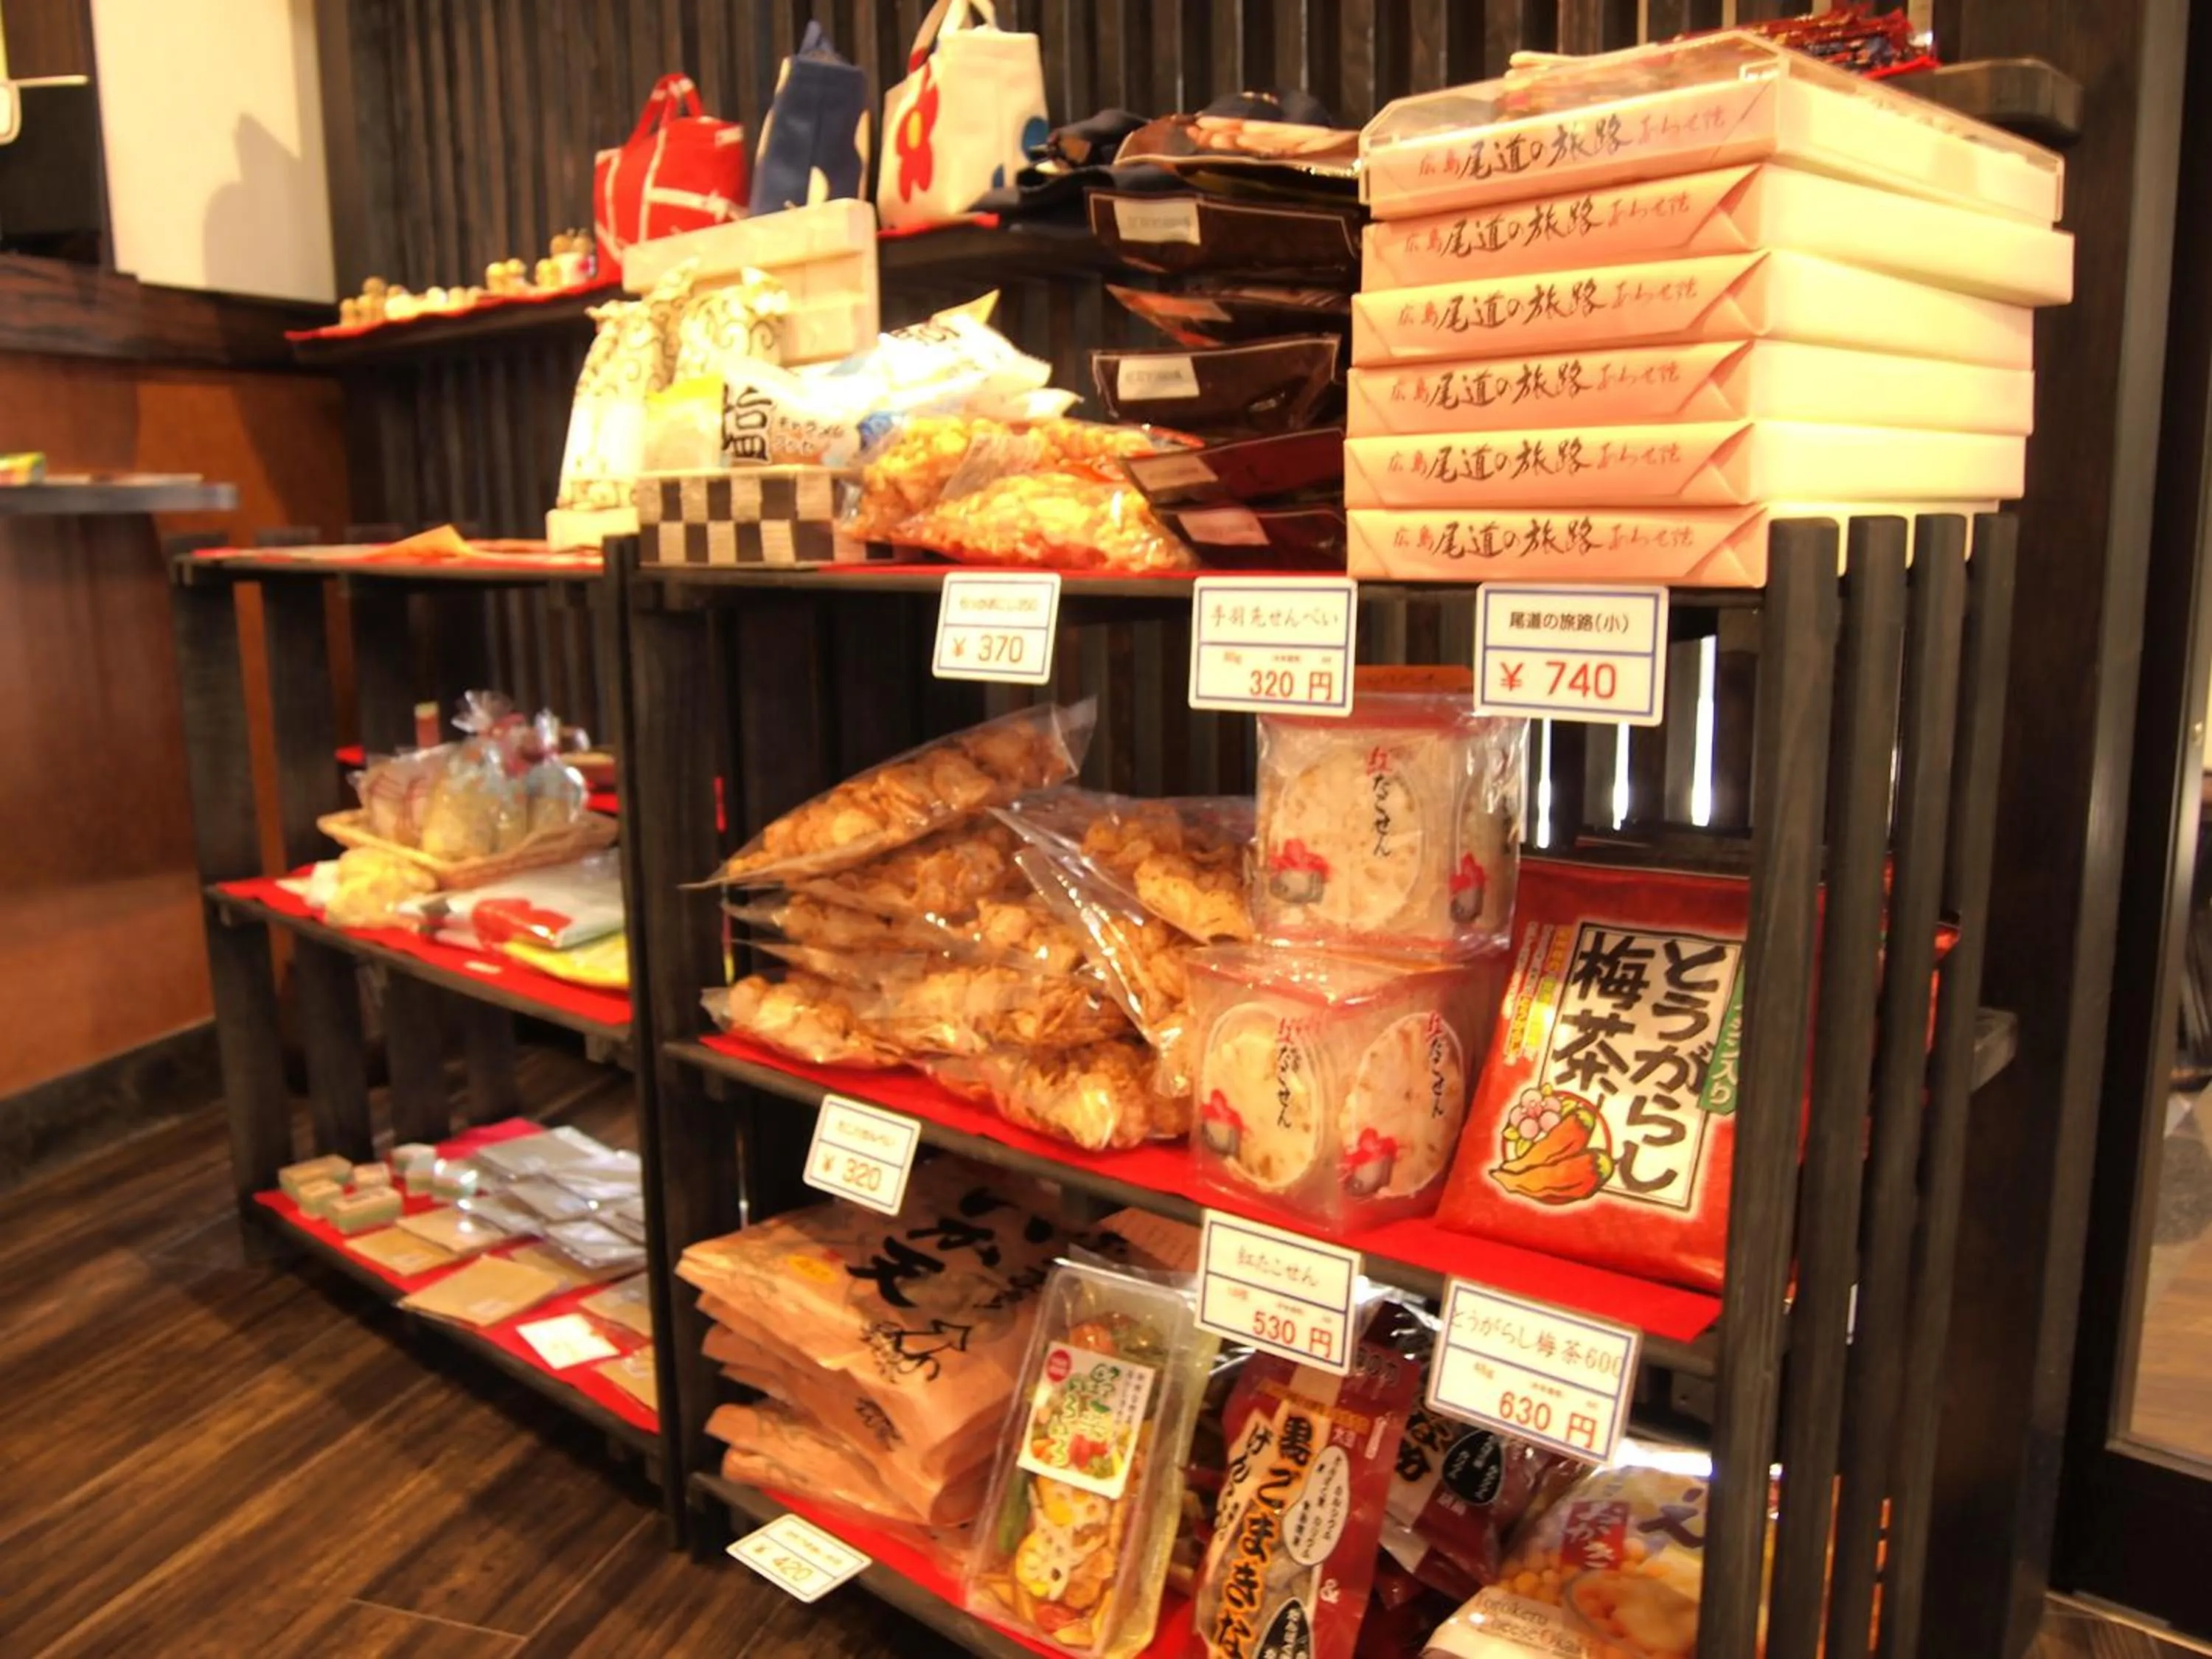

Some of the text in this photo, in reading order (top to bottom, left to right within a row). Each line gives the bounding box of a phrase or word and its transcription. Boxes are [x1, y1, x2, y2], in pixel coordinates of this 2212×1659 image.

[978, 633, 1024, 664] 370
[1250, 669, 1333, 703] 320 円
[1545, 661, 1617, 700] 740
[1551, 931, 1658, 1096] 梅茶
[1618, 939, 1728, 1194] とうがらし
[1253, 1310, 1332, 1359] 530 円
[1498, 1390, 1552, 1432] 630
[1566, 1411, 1597, 1450] 円
